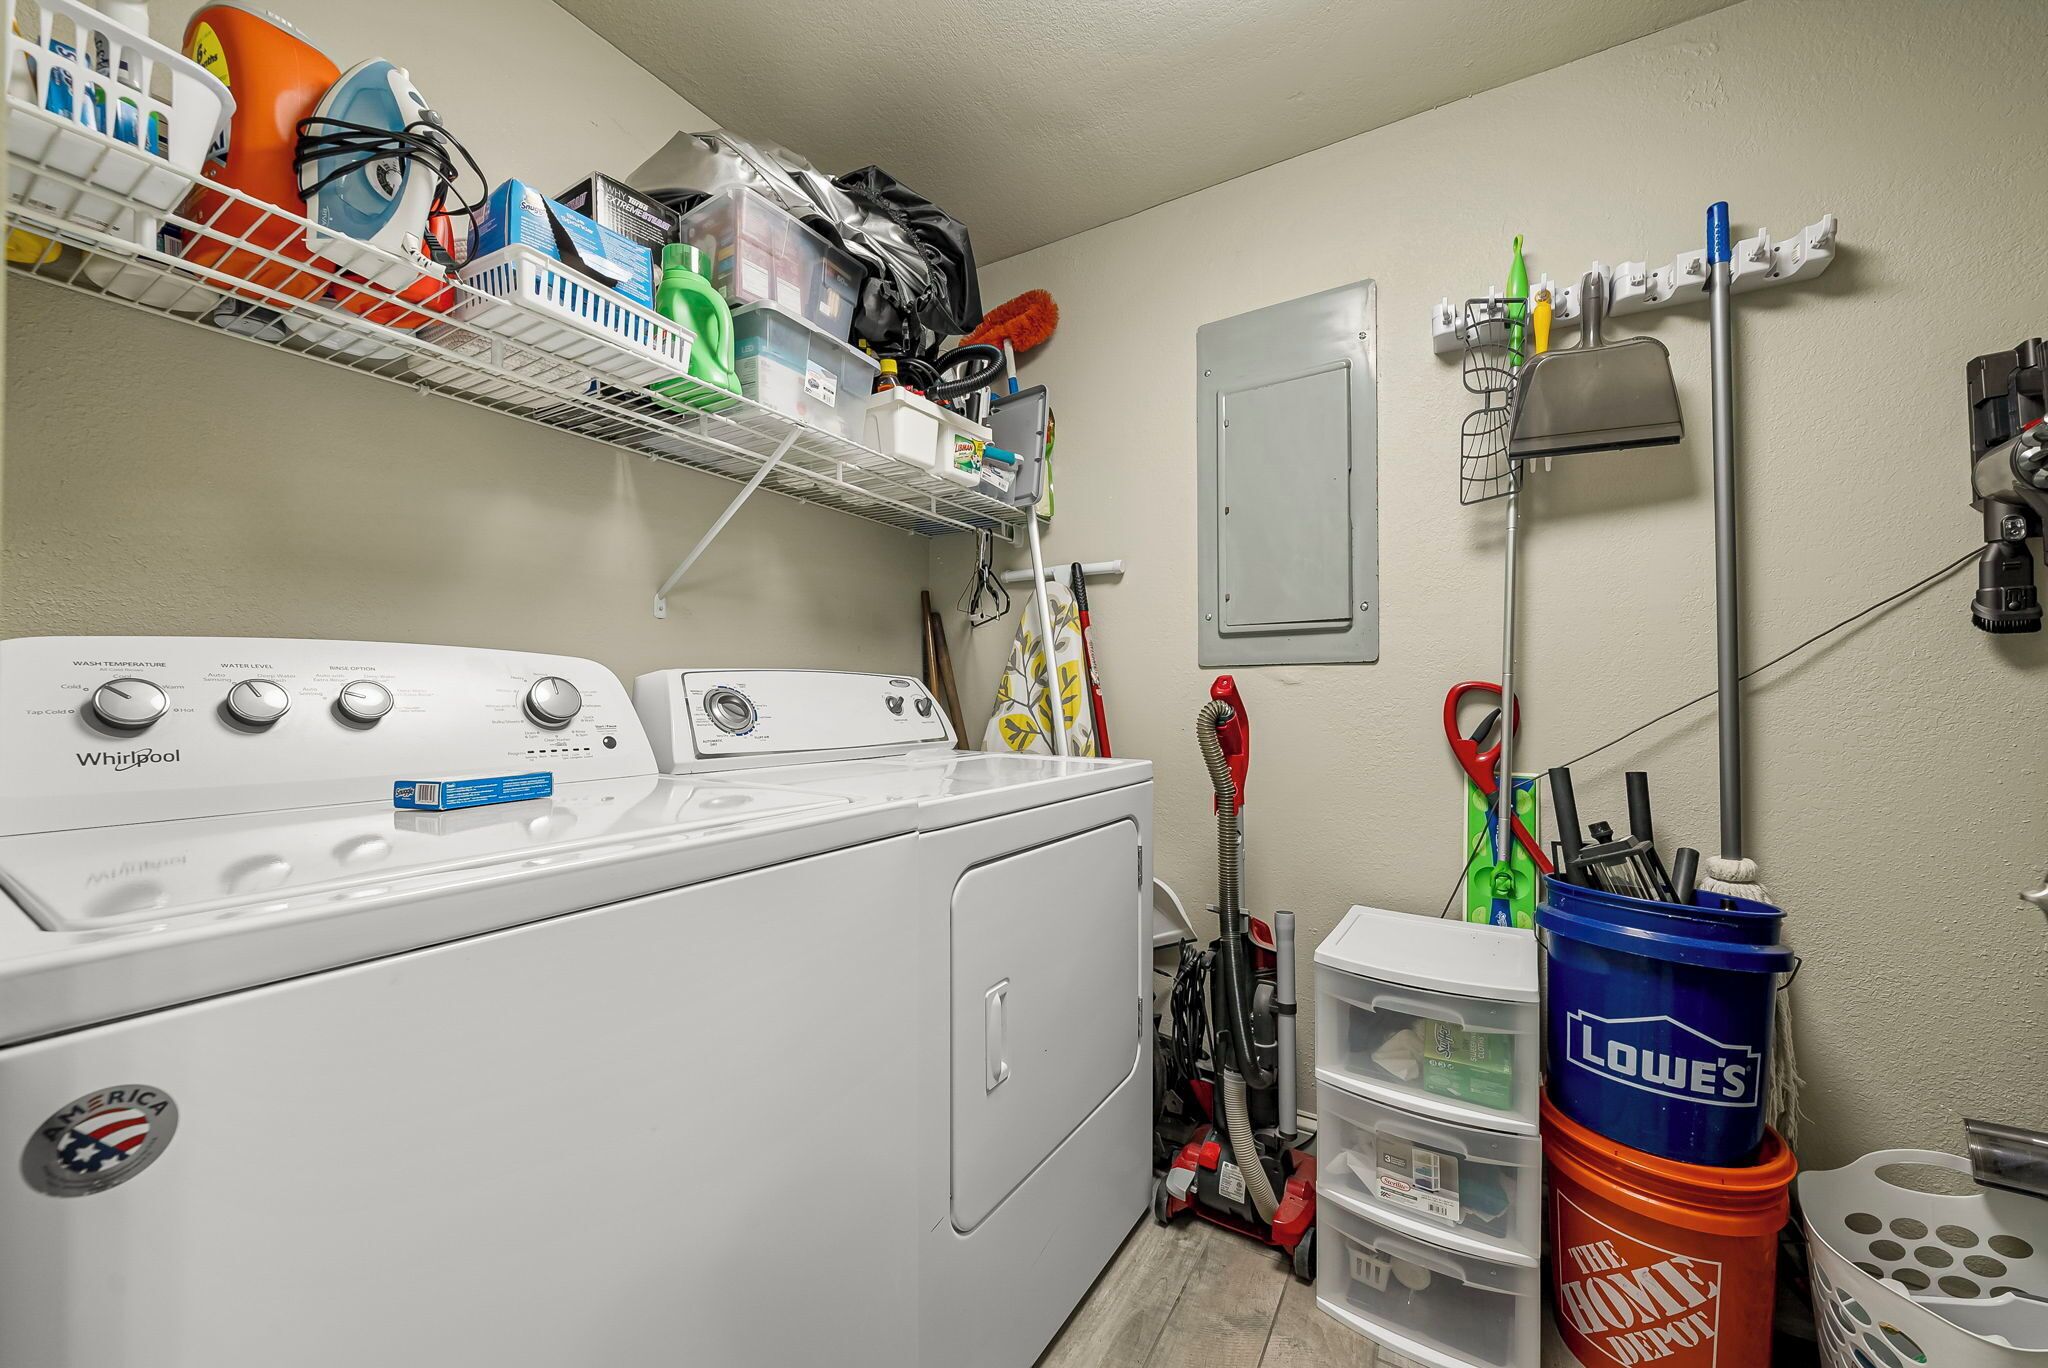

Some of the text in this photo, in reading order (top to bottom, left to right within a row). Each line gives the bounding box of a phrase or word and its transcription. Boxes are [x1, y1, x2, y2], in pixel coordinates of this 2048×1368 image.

[605, 183, 627, 200] WHY
[954, 442, 974, 453] LIBMAN
[76, 748, 180, 771] Whirlpool
[395, 787, 415, 797] Snuggle
[1434, 1023, 1454, 1060] Swiffer
[1582, 1024, 1748, 1098] LOWE'S
[43, 1088, 169, 1142] AMERICA
[1384, 1154, 1391, 1163] 3
[1567, 1239, 1628, 1275] THE
[1562, 1256, 1719, 1335] HOME
[1605, 1310, 1718, 1368] DEPOT
